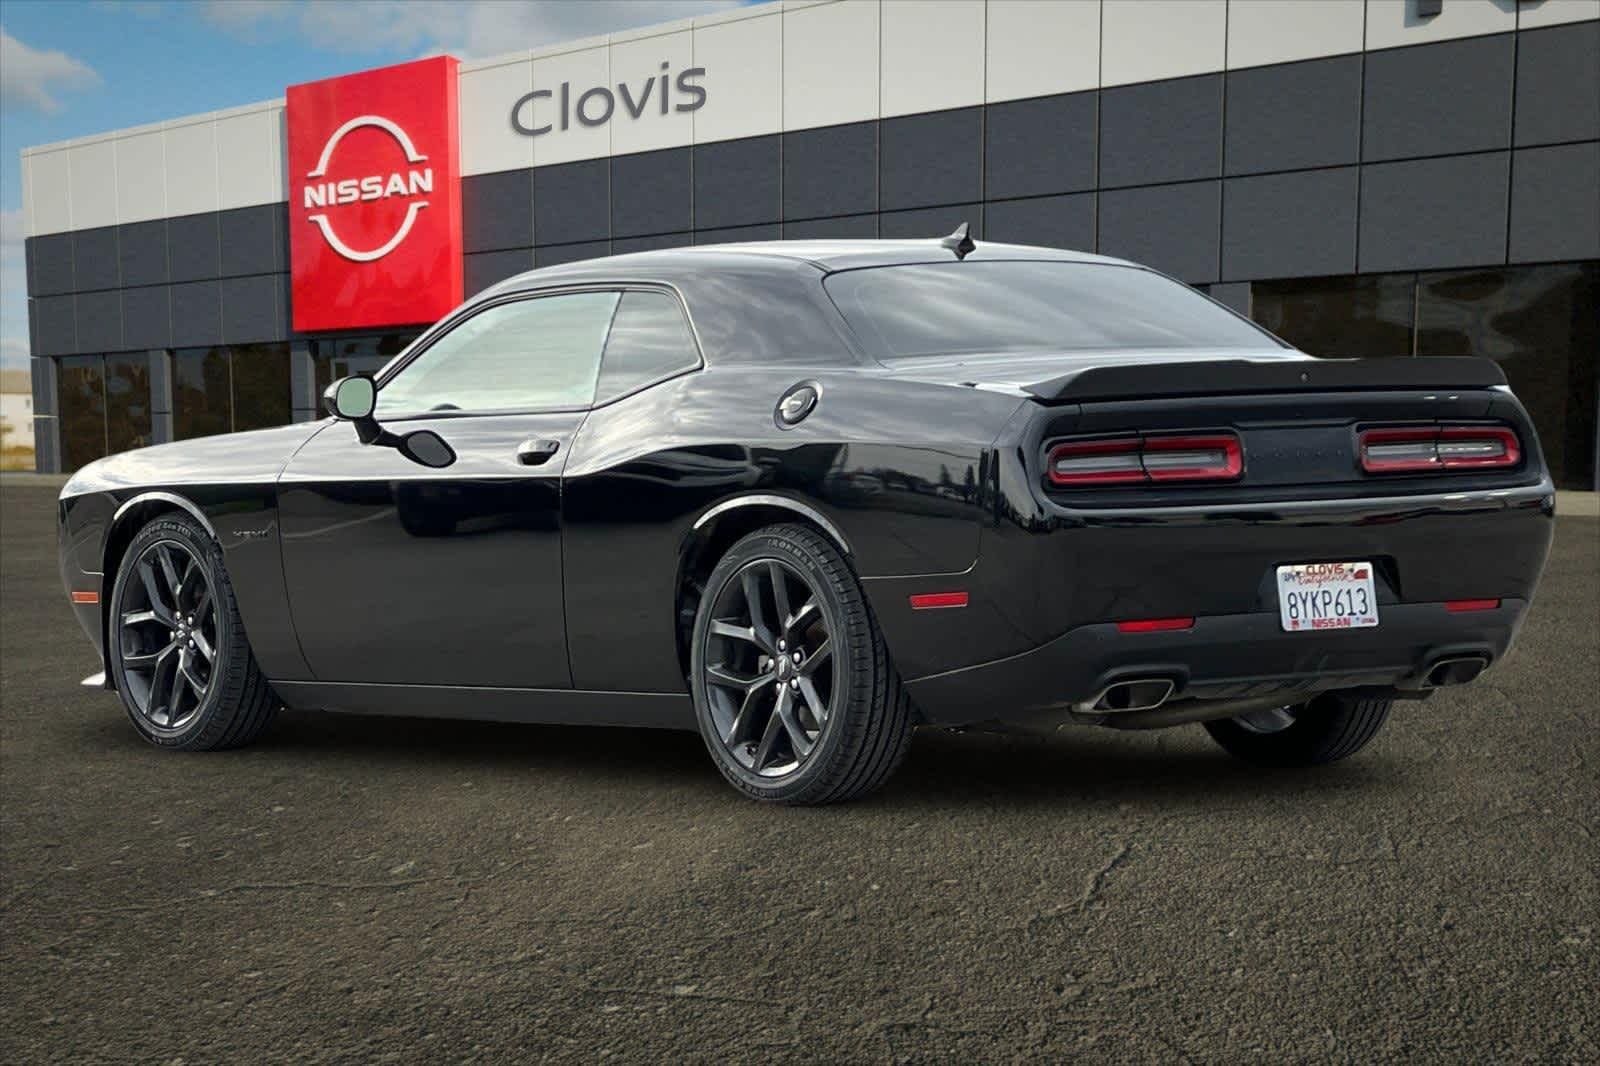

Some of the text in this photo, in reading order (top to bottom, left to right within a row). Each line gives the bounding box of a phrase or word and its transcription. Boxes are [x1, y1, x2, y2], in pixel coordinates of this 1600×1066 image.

[511, 61, 707, 137] Clovis
[304, 168, 433, 208] NISSAN
[1306, 564, 1345, 576] CLOVIS
[1287, 588, 1369, 619] 8YKP613
[1311, 617, 1351, 629] NISSAN
